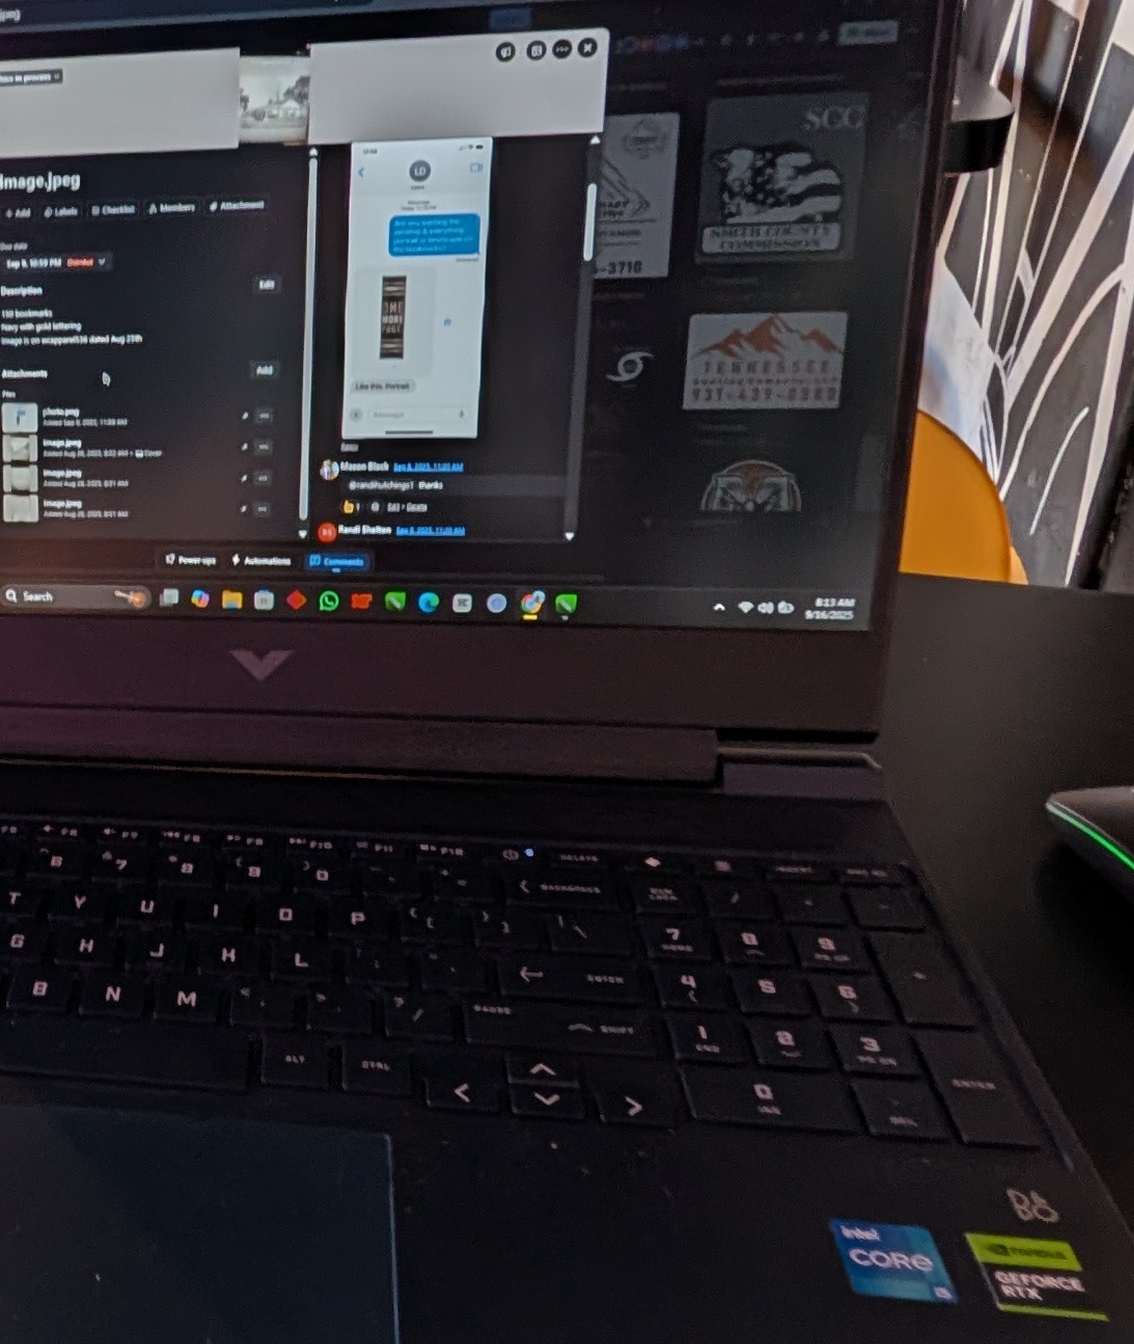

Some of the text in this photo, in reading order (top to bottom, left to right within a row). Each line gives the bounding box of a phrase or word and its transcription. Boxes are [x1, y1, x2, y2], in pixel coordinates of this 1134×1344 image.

[22, 590, 53, 603] Search
[9, 890, 22, 905] T
[74, 894, 87, 910] Y
[140, 898, 154, 913] U
[350, 911, 366, 925] P
[10, 933, 25, 949] G
[79, 937, 94, 954] H
[149, 942, 164, 957] J
[294, 952, 309, 967] L
[32, 981, 48, 997] B
[105, 985, 121, 1002] N
[176, 990, 197, 1007] M
[994, 1270, 1087, 1294] GEFORCE
[1001, 1285, 1044, 1302] RTX
